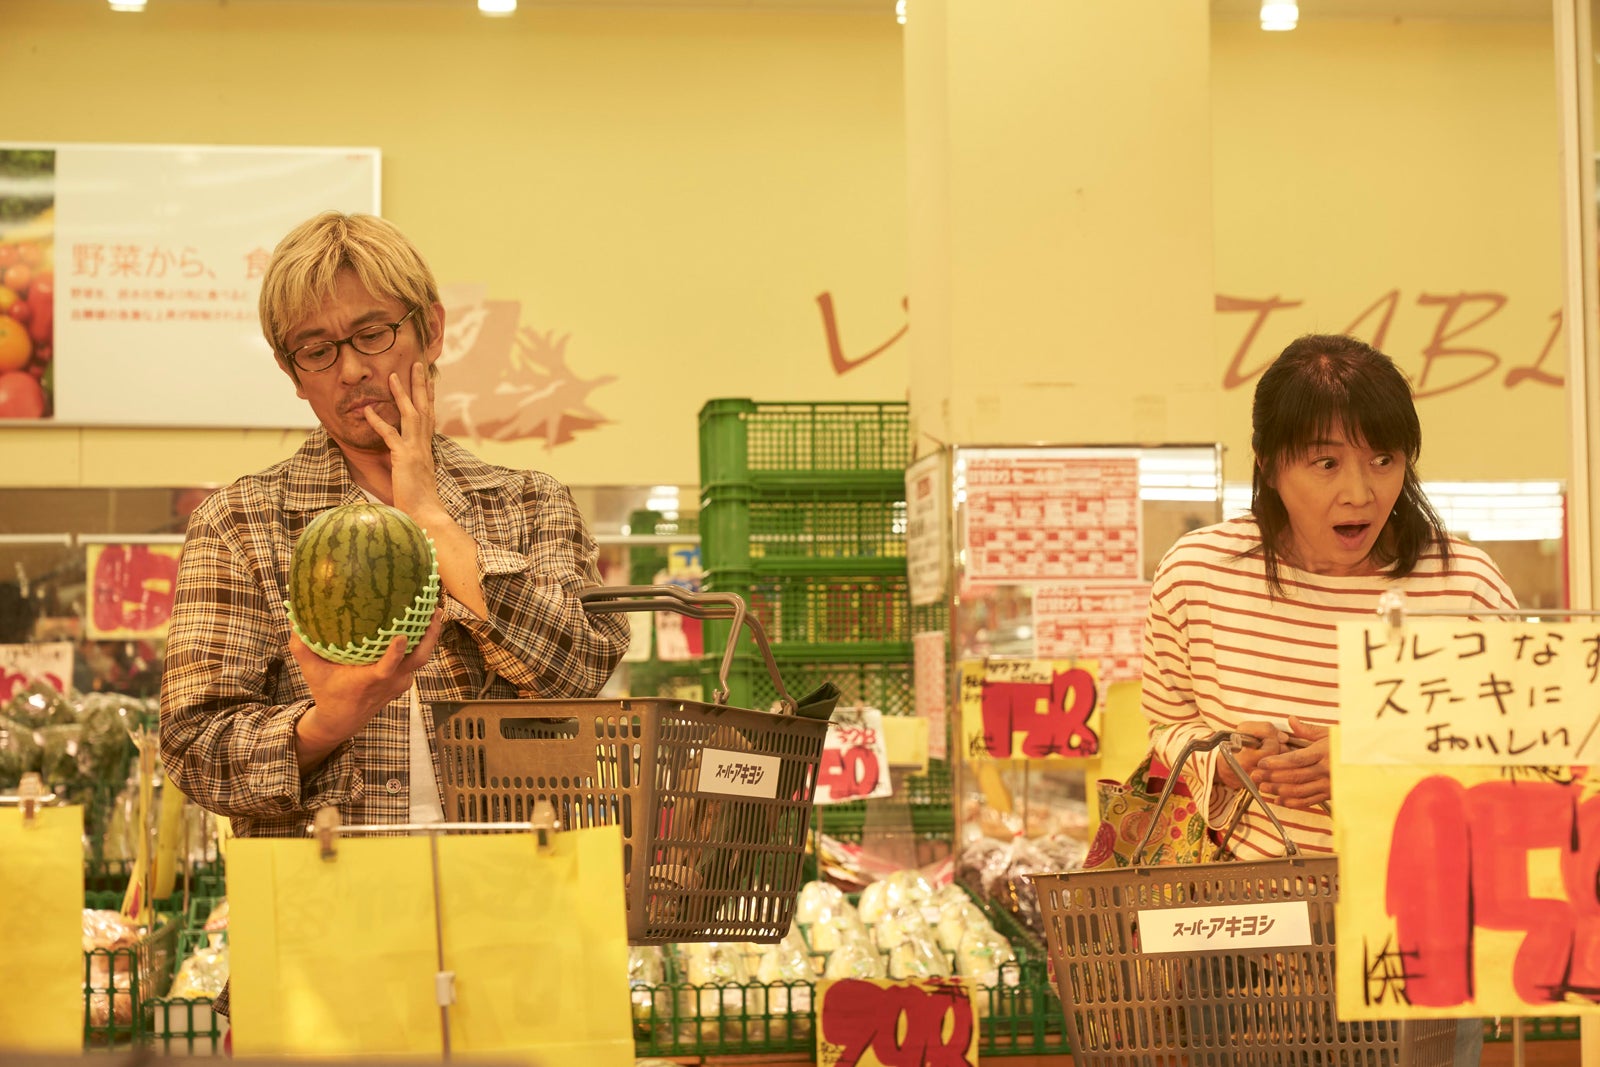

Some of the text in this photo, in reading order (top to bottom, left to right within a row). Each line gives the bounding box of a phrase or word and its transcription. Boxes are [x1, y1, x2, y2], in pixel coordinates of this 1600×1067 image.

[1373, 672, 1562, 720] ステーキに
[715, 762, 765, 786] スーパーアキヨシ
[1172, 915, 1276, 939] スーパーアキヨシ
